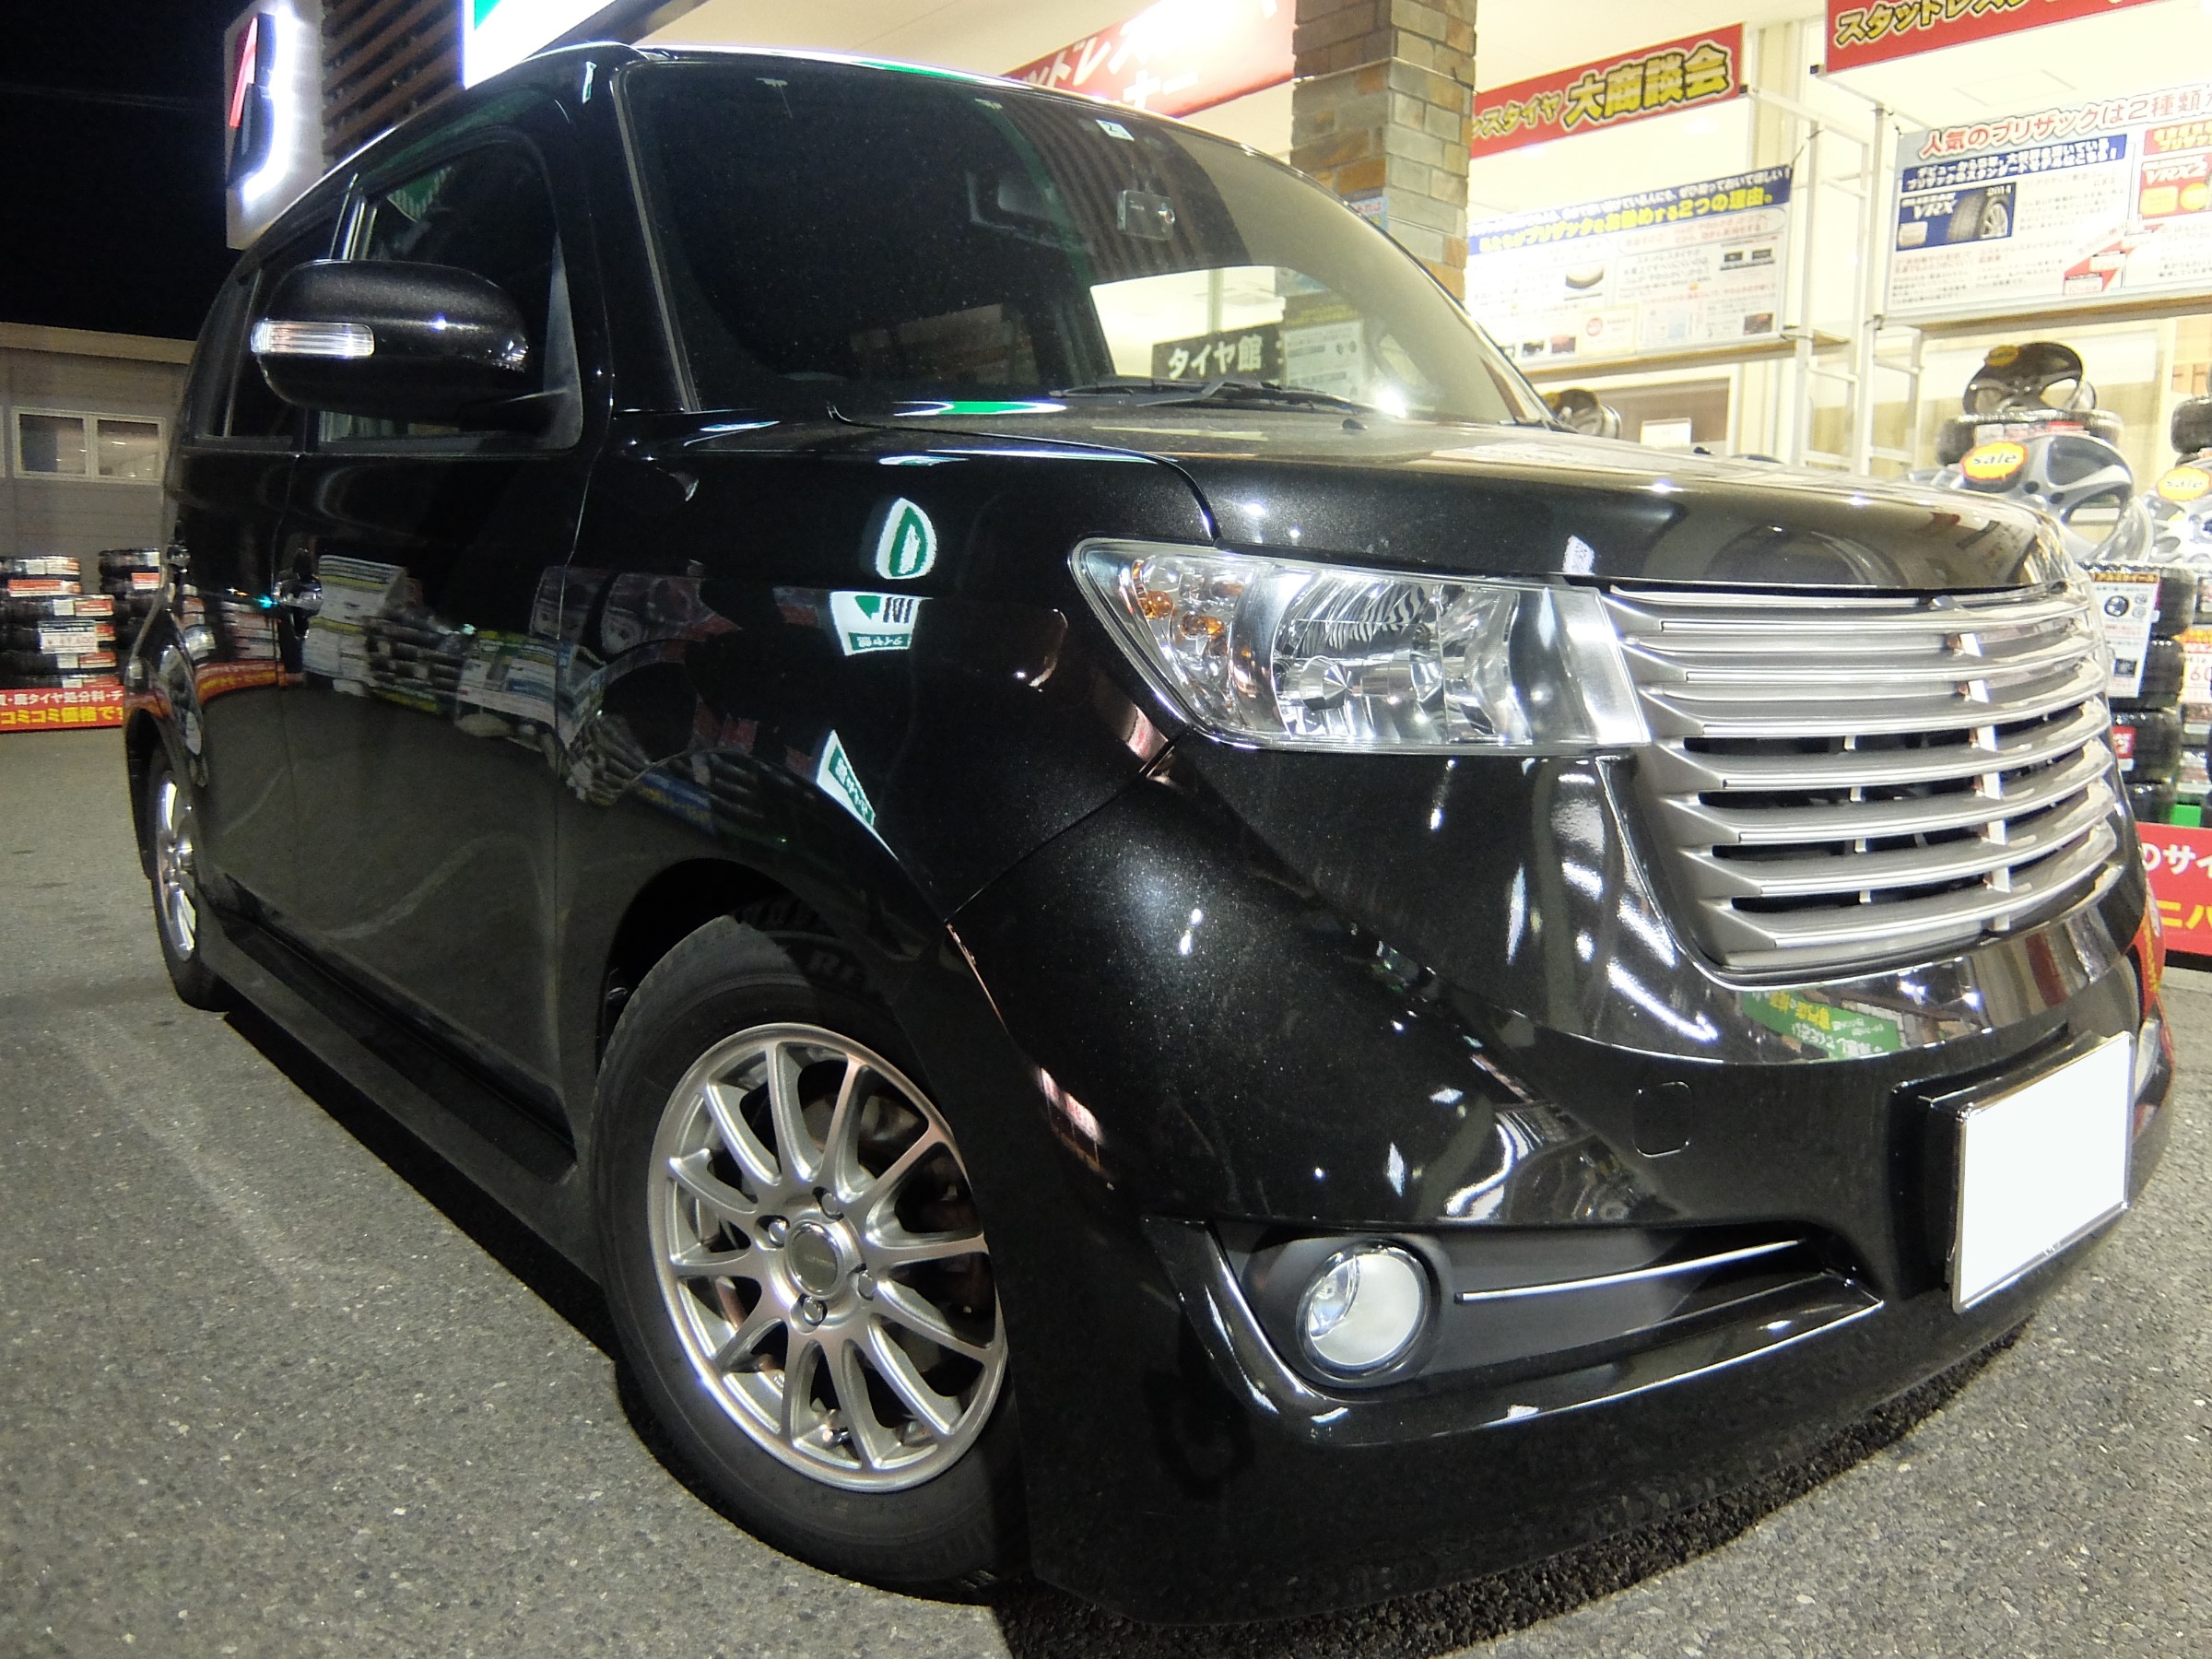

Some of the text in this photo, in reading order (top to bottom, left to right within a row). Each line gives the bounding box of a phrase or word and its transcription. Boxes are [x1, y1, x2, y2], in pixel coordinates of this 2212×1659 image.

[1564, 42, 1733, 129] 大商談会
[1167, 334, 1263, 381] タイヤ館
[1971, 451, 2018, 466] sale
